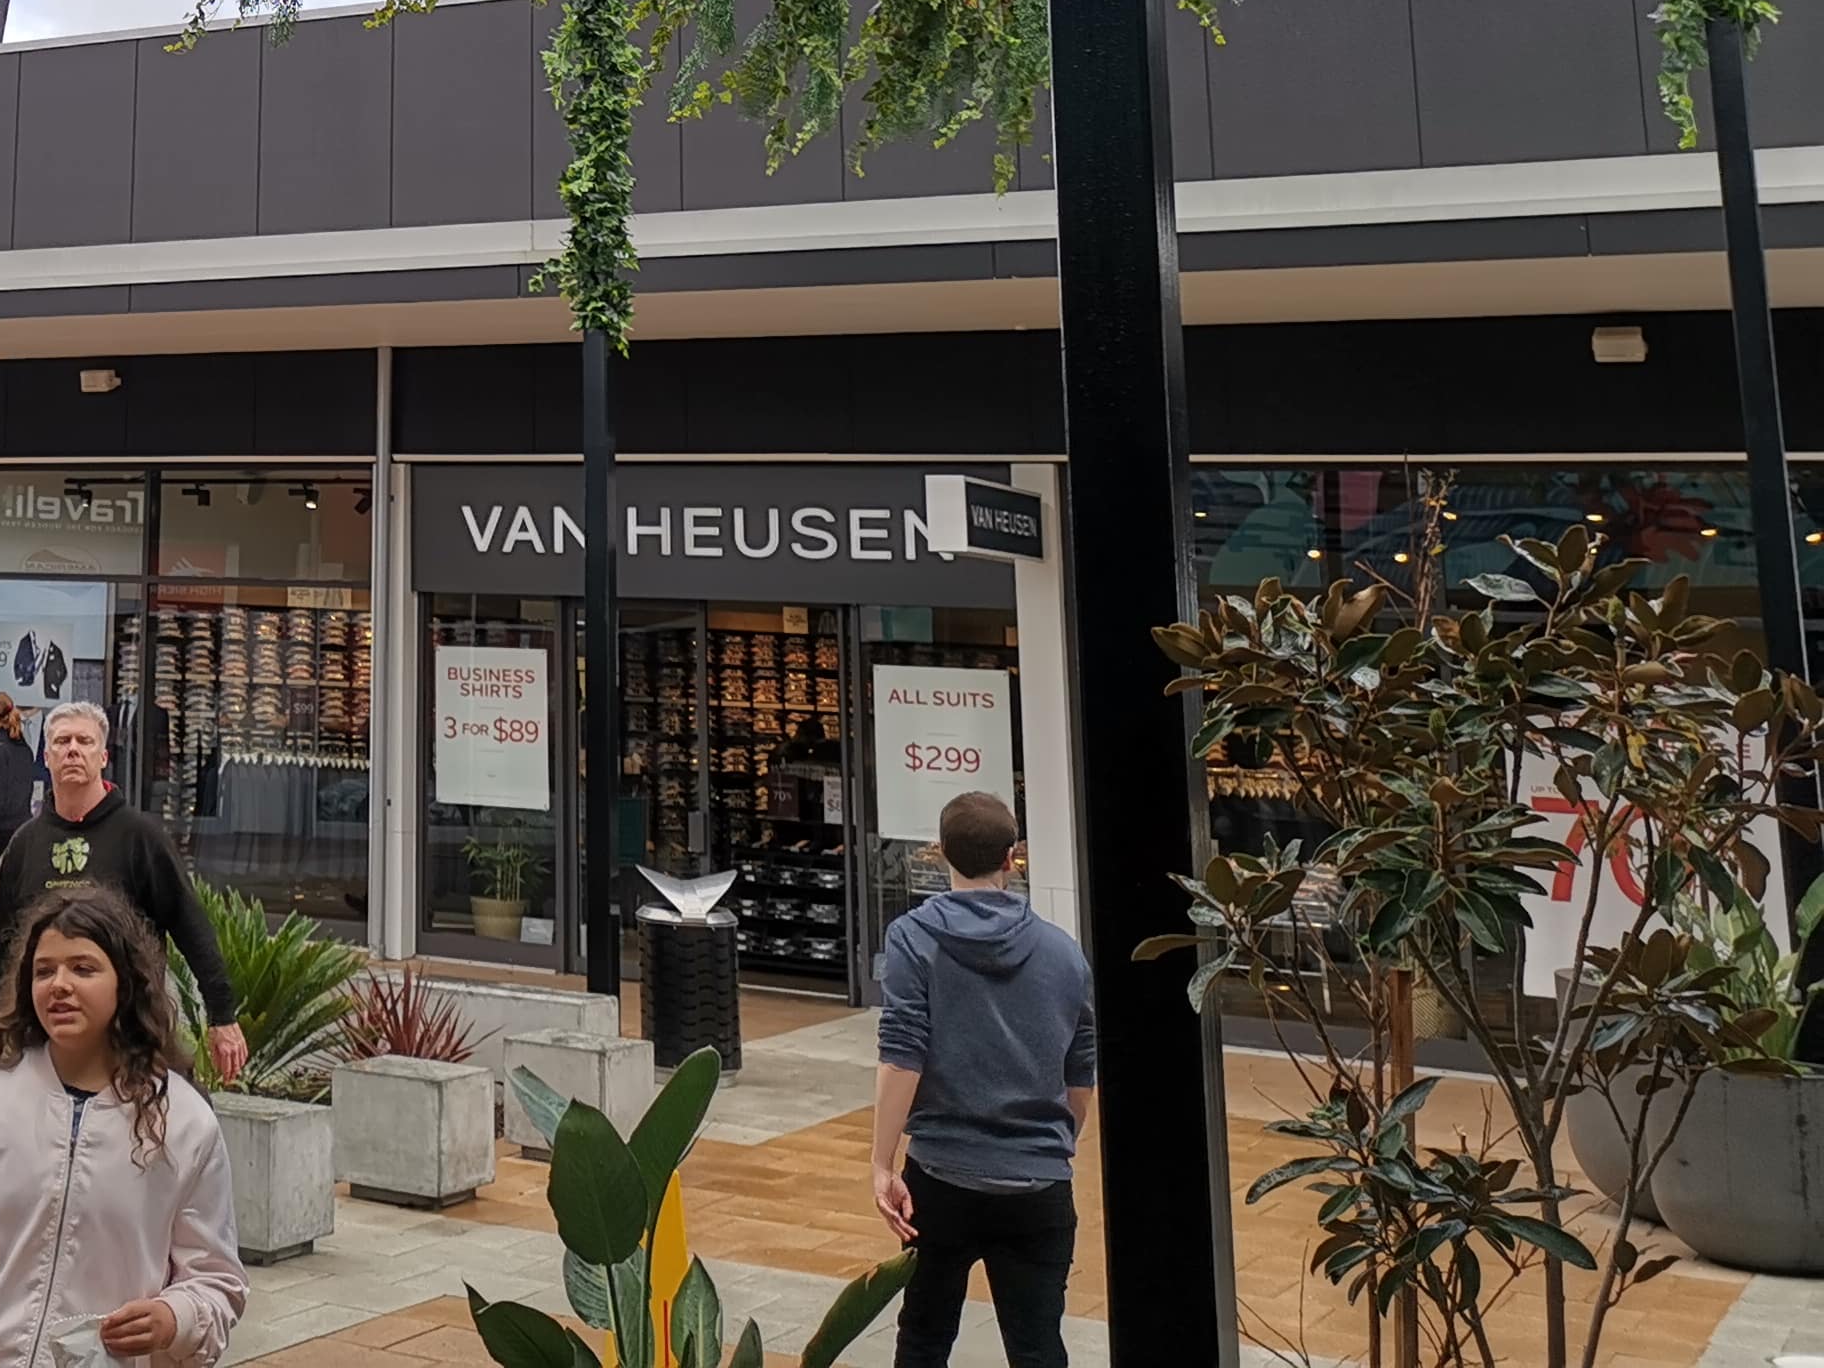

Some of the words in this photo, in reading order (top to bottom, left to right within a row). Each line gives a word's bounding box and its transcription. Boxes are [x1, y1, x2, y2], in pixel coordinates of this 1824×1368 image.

[460, 504, 586, 554] VAN
[971, 504, 994, 529] VAN
[994, 508, 1038, 537] HEUSEN
[447, 666, 536, 684] BUSINESS
[459, 683, 523, 699] SHIRTS
[888, 688, 928, 705] ALL
[932, 690, 995, 709] SUITS
[293, 702, 314, 714] $99
[443, 716, 457, 739] 3
[462, 723, 489, 736] FOR
[1530, 785, 1545, 793] UP
